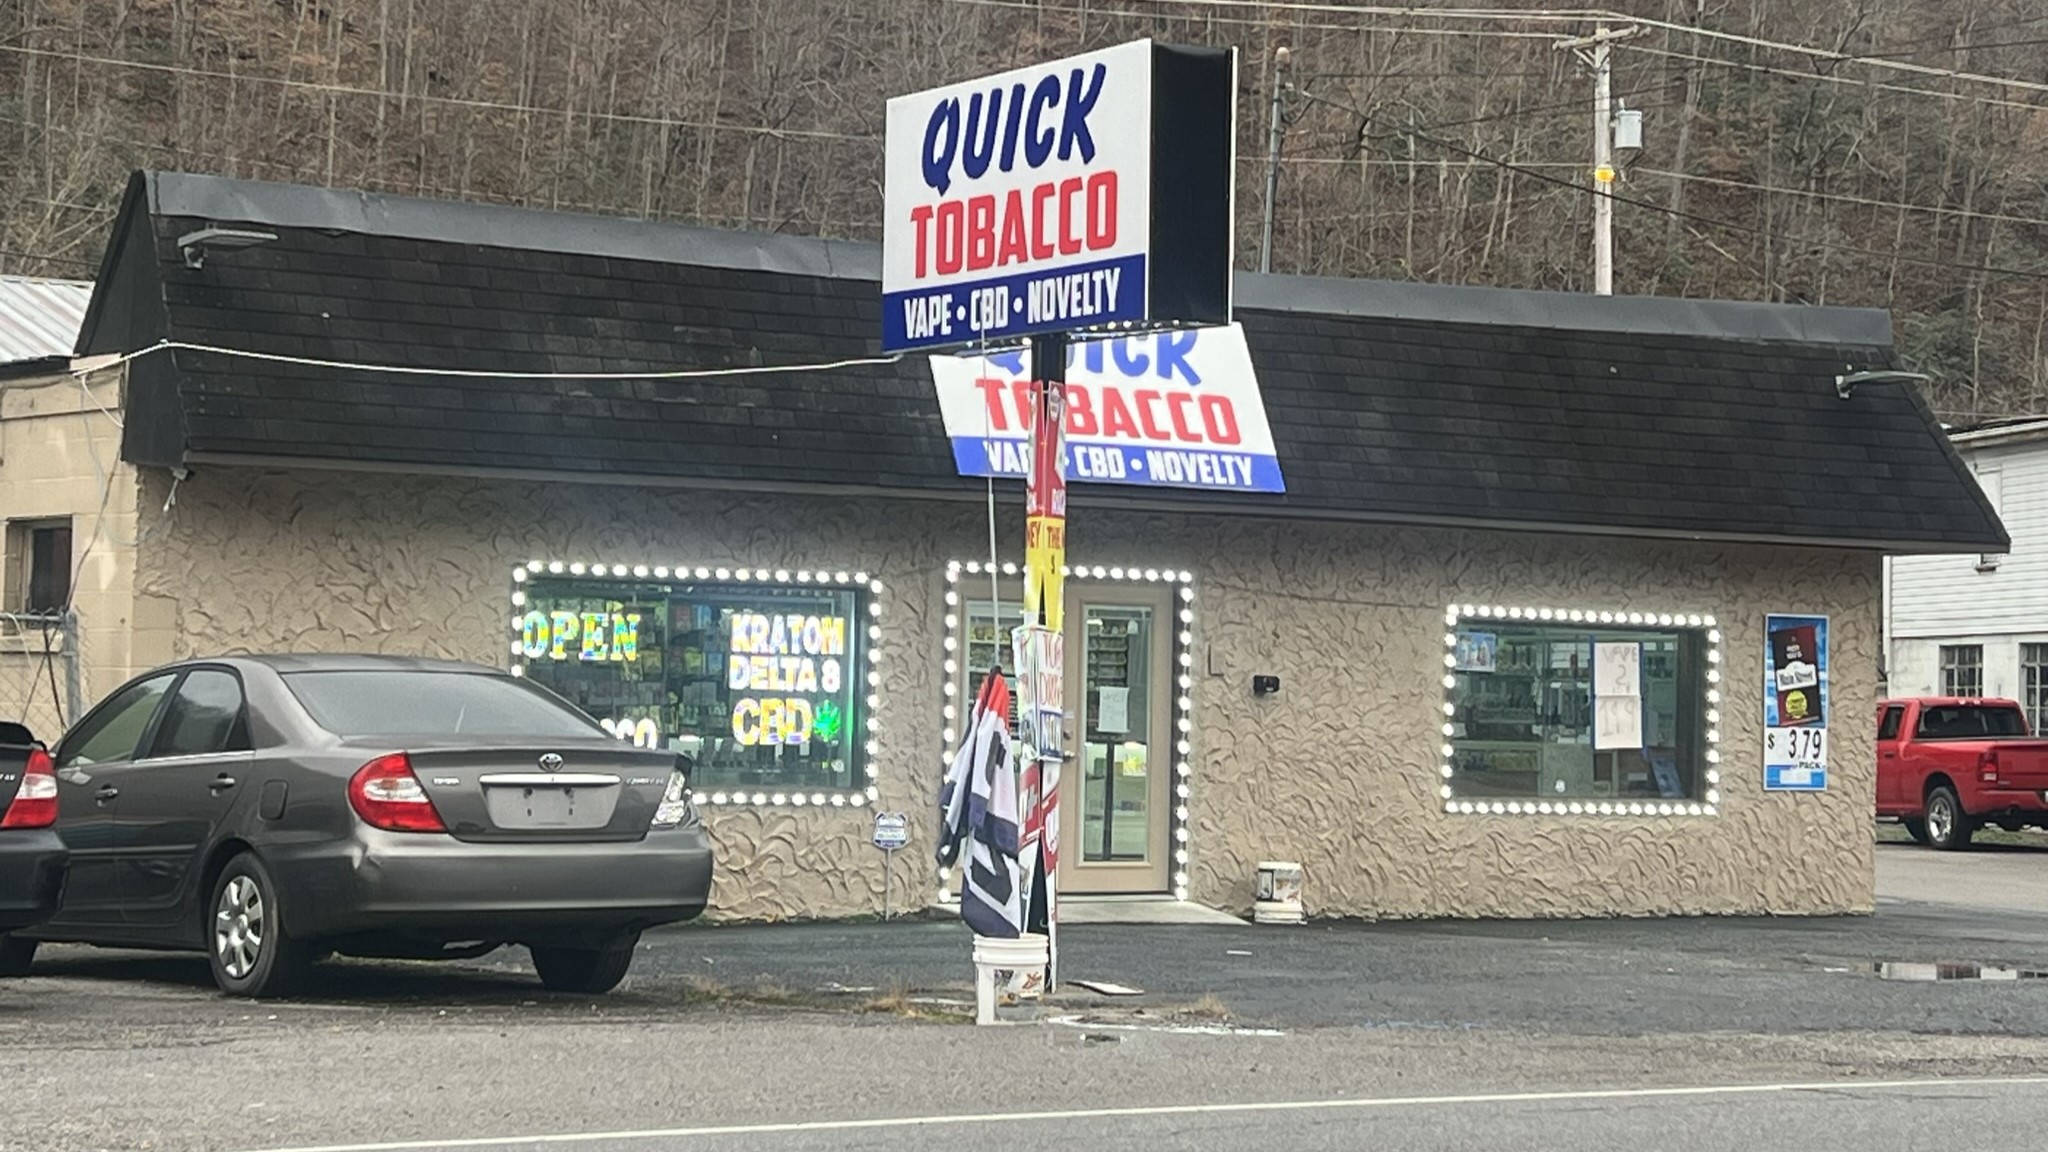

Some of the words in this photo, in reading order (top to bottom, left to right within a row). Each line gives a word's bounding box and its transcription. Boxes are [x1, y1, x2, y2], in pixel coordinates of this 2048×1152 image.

[921, 61, 1107, 197] QUICK
[909, 170, 1119, 279] TOBACCO
[903, 291, 954, 339] VAPE
[969, 285, 1010, 332] CBD
[1026, 267, 1122, 326] NOVELTY
[1074, 446, 1127, 480] CBD
[1146, 454, 1253, 488] NOVELTY
[522, 610, 642, 662] OPEN
[730, 613, 846, 656] KRATOM
[729, 654, 818, 692] DELTA
[820, 657, 842, 693] 8
[731, 697, 813, 747] CBD
